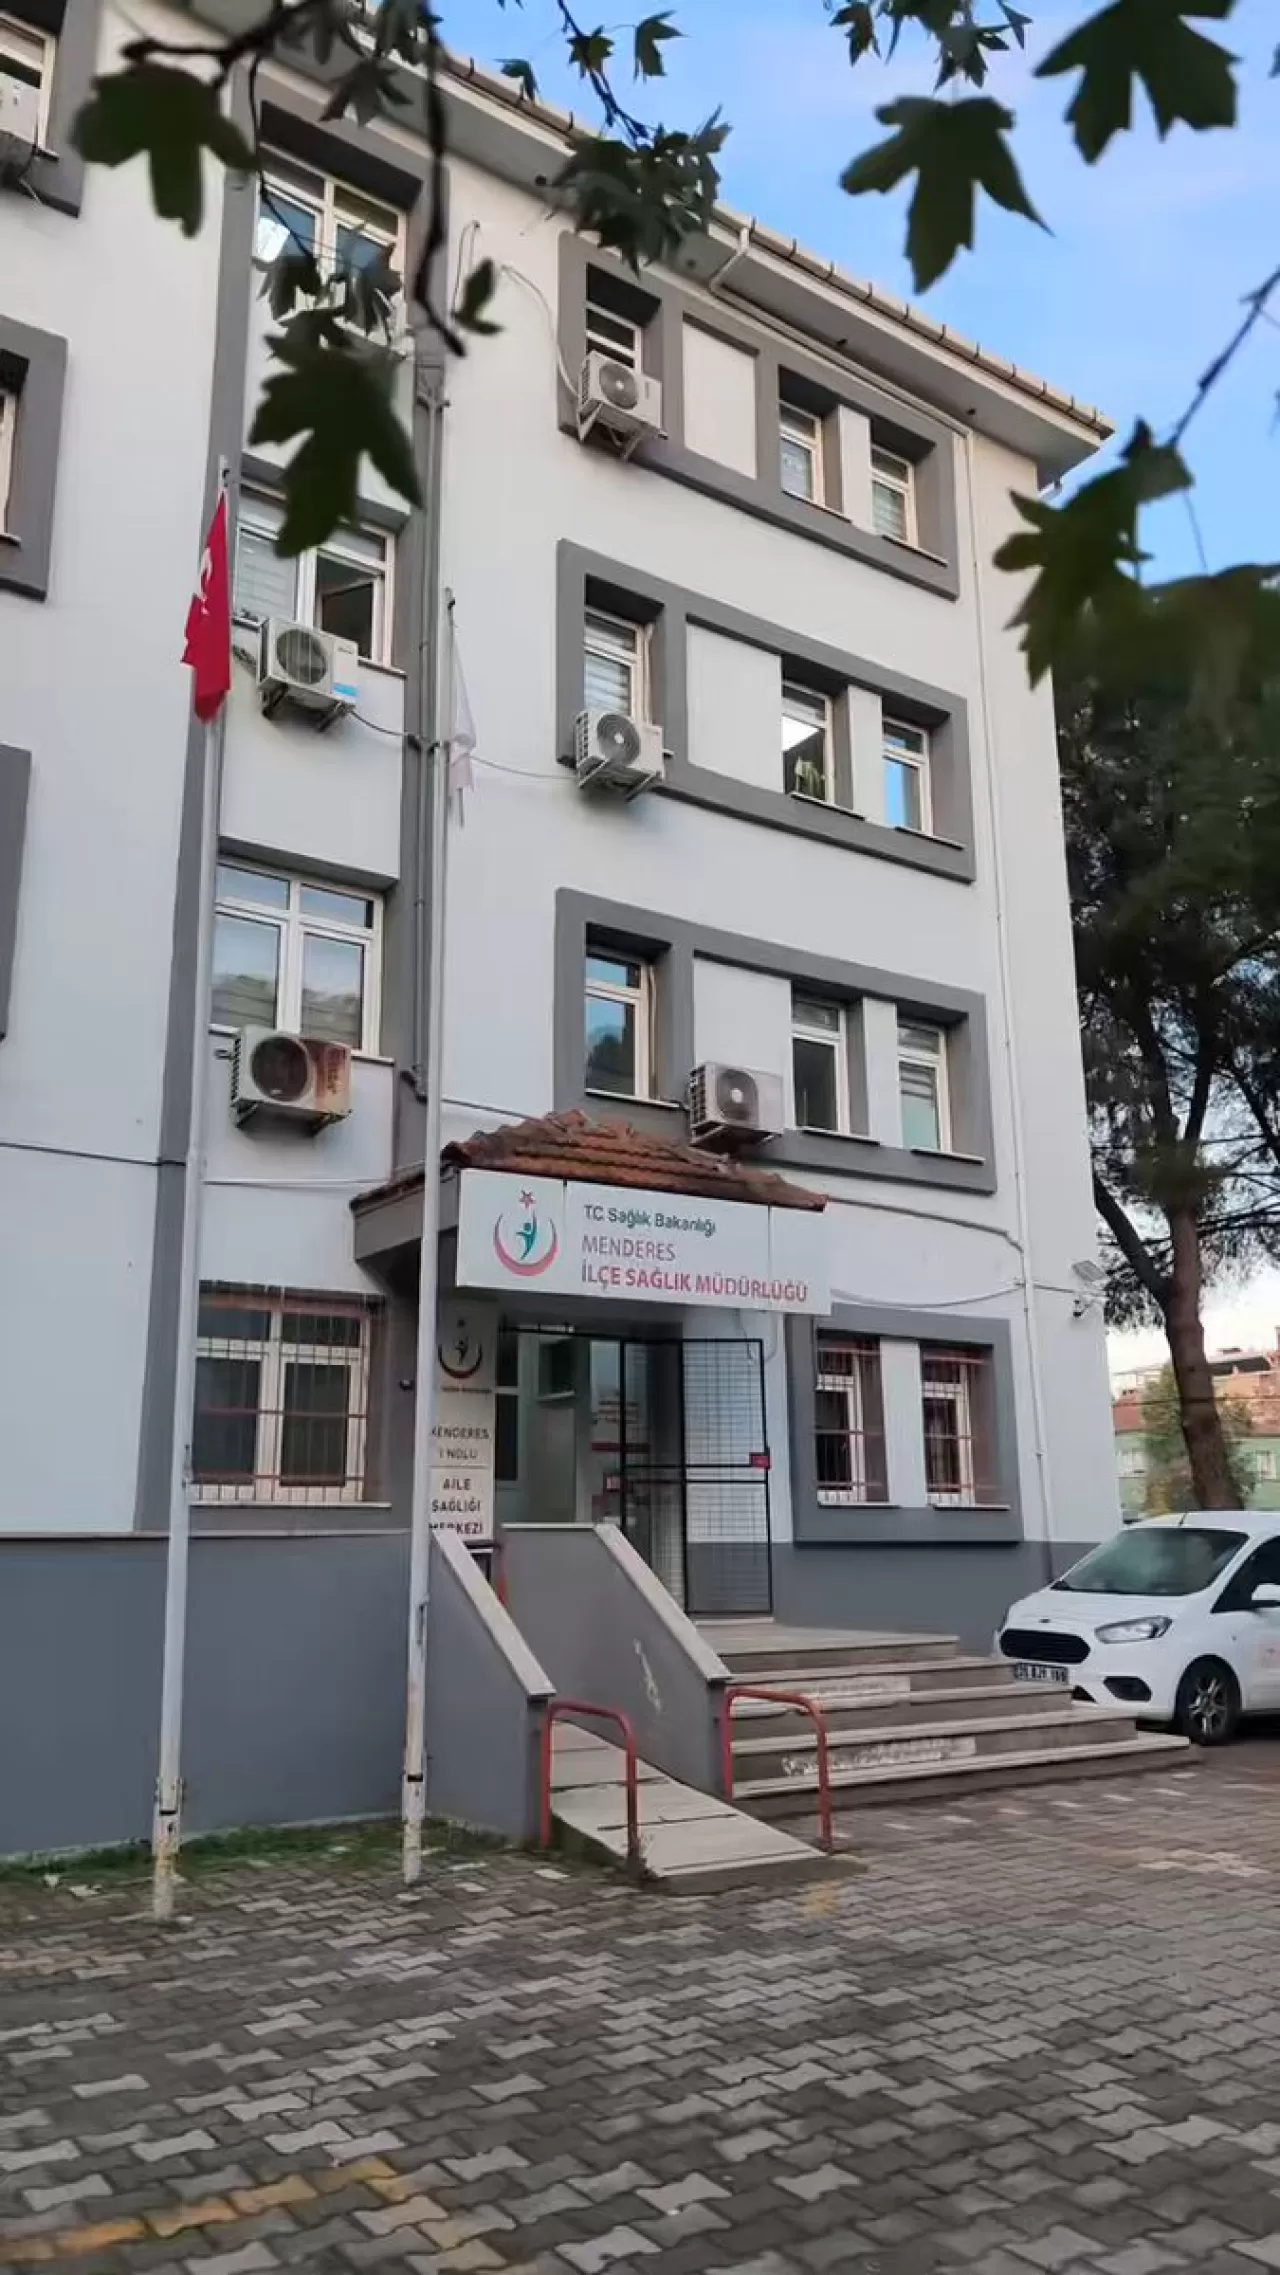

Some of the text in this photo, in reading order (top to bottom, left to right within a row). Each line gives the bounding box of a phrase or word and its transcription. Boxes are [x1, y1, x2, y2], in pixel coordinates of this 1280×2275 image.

[608, 1207, 651, 1229] Sağlık
[655, 1212, 716, 1238] Bakanlığı
[582, 1235, 676, 1262] MENDERES
[581, 1259, 808, 1303] İLÇE SAĞLIK MÜDÜRLÜĞÜ
